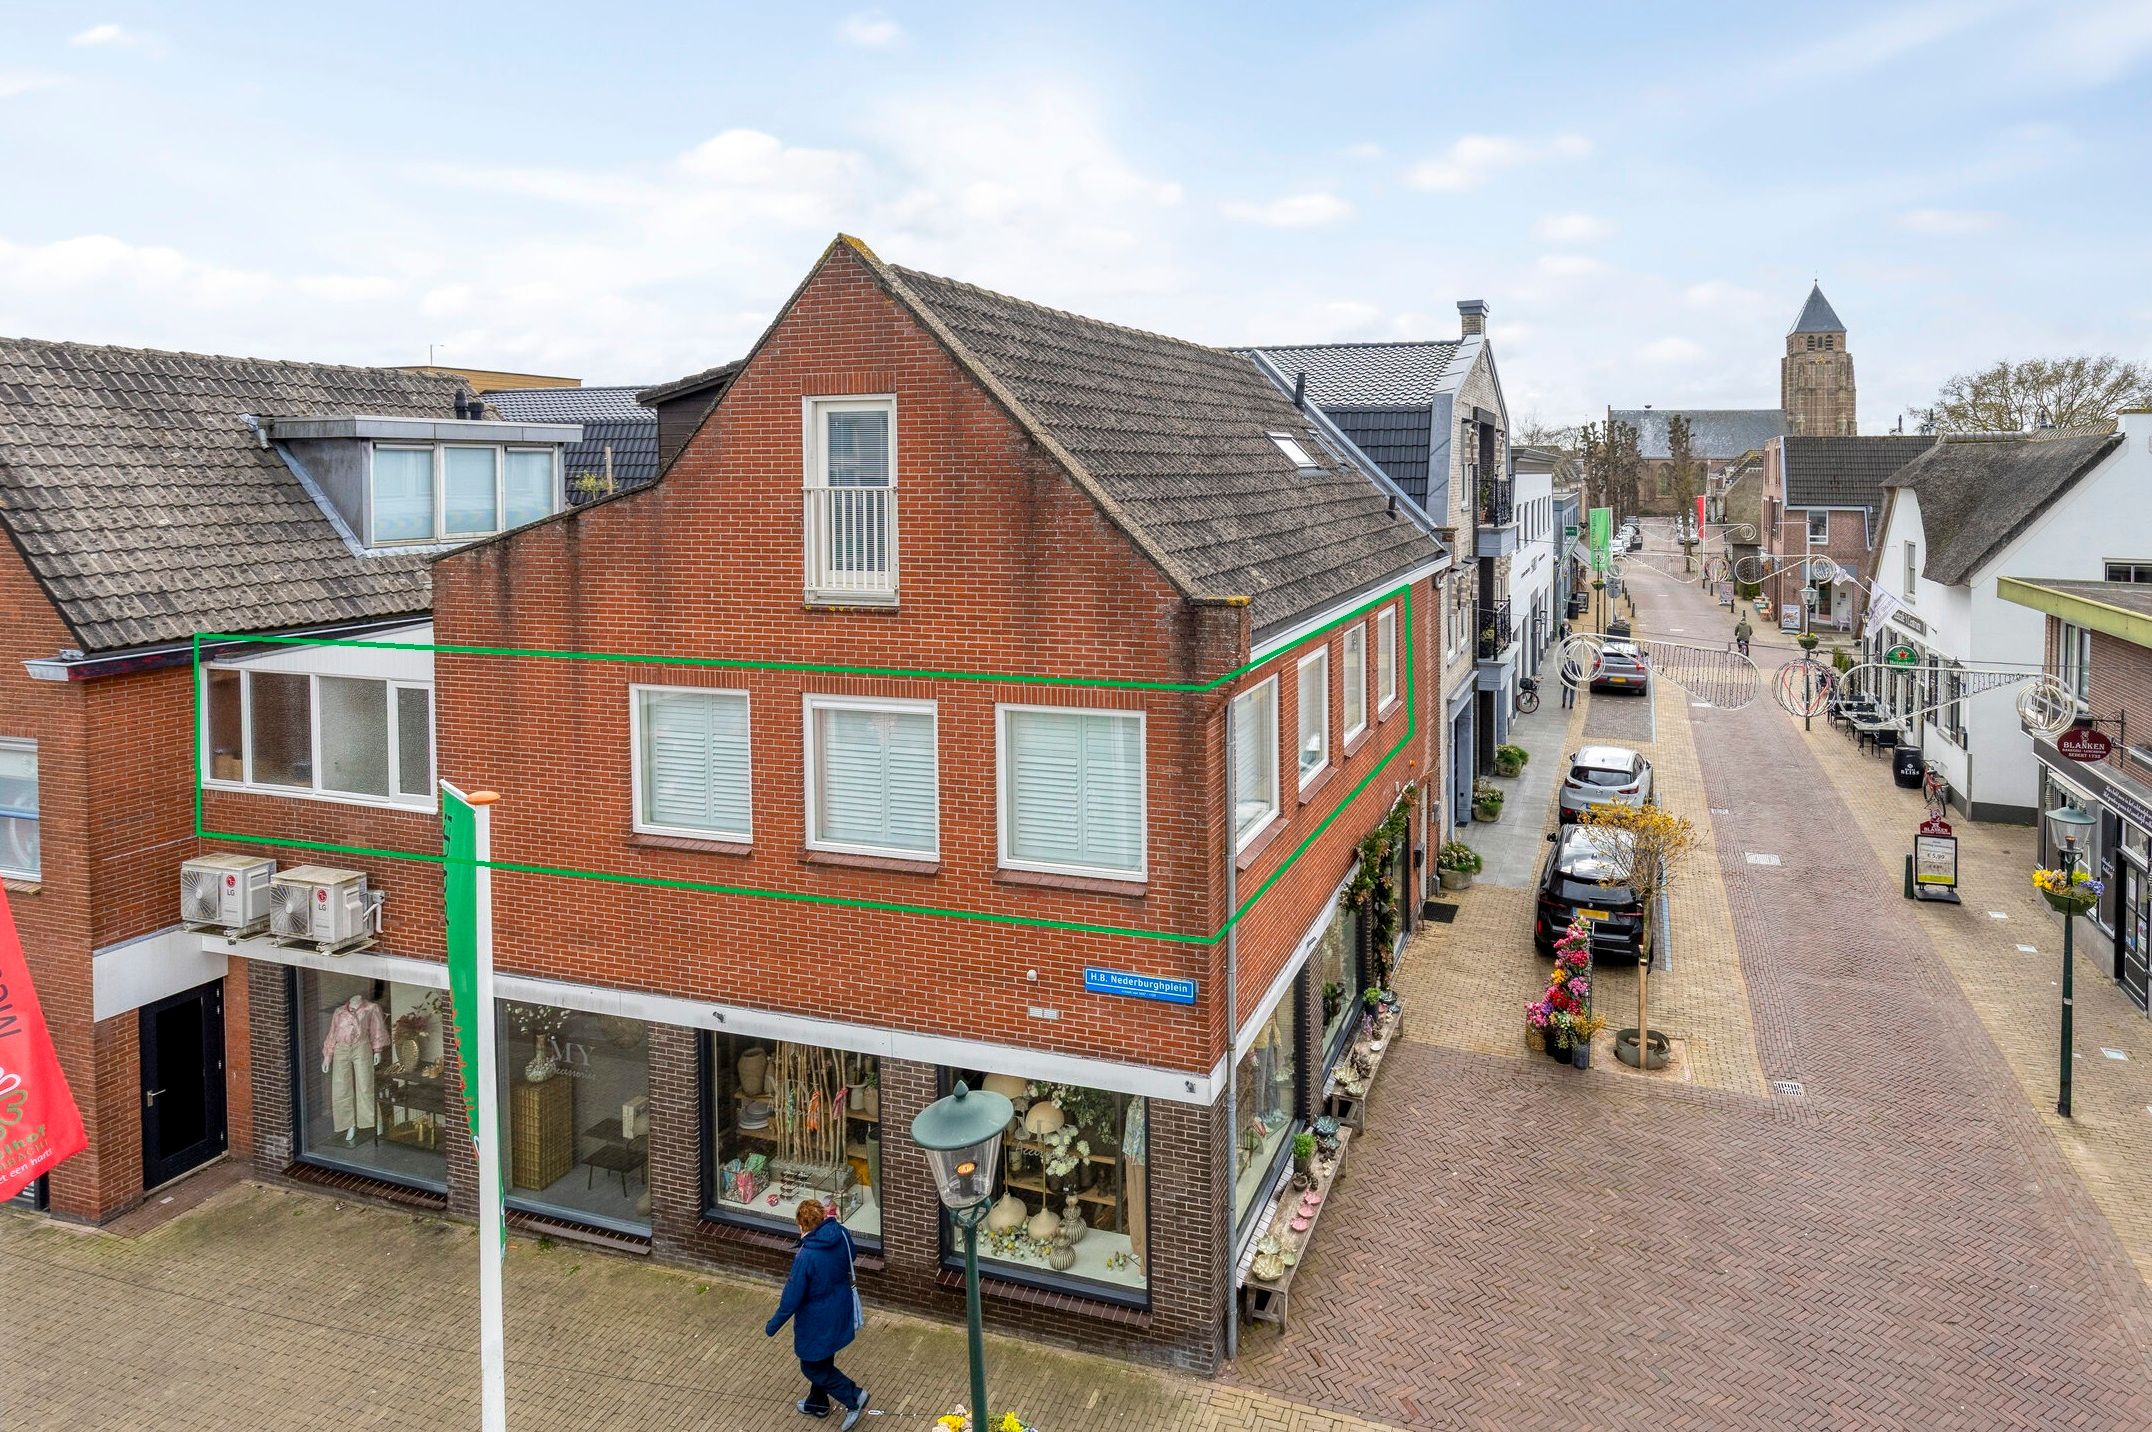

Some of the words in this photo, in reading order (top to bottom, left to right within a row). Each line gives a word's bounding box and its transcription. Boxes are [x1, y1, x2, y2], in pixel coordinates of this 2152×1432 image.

[2063, 742, 2105, 750] BLANKEN
[318, 903, 327, 911] LG
[1090, 972, 1108, 982] H.B.
[1111, 975, 1188, 993] Nederburghplein
[548, 1039, 596, 1066] MY
[9, 1163, 28, 1177] een
